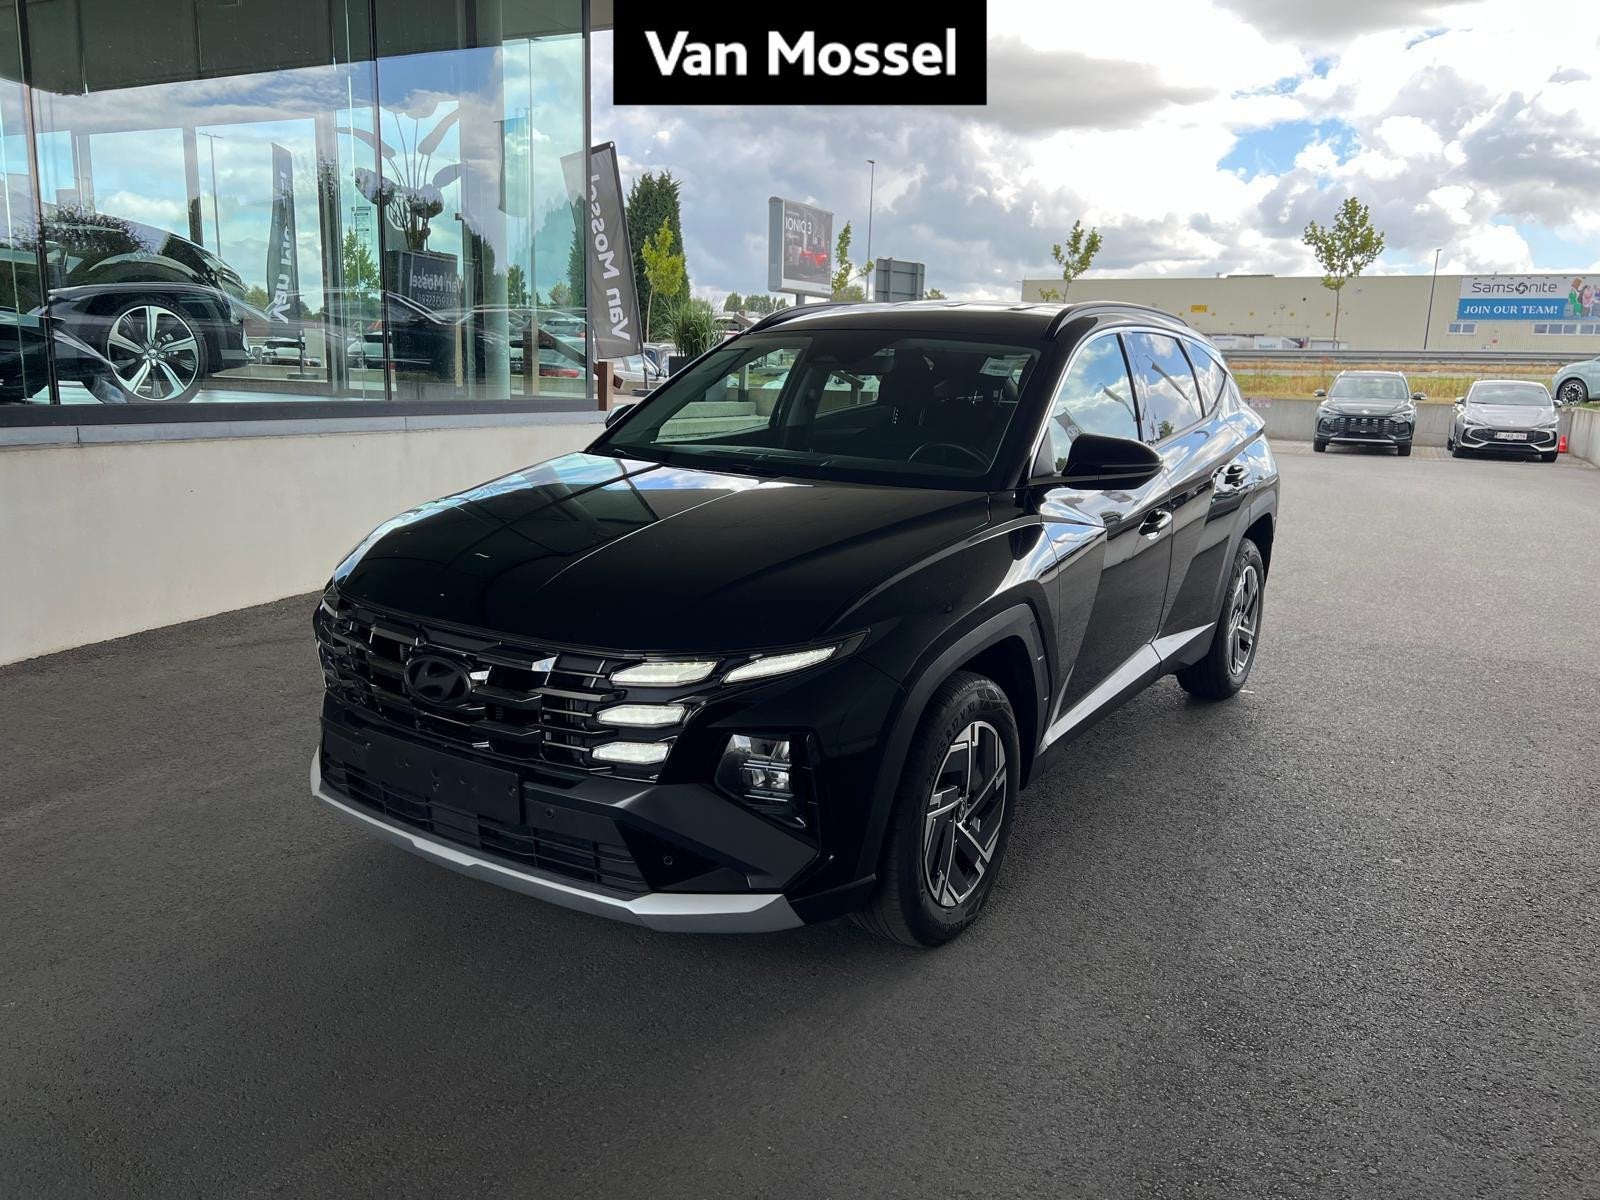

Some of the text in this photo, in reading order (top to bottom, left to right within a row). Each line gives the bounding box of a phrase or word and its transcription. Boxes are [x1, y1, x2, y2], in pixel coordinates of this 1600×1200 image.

[785, 216, 813, 235] IONIQ 3
[1472, 282, 1558, 295] Samsonite
[1464, 305, 1558, 314] JOIN OUR TEAM!
